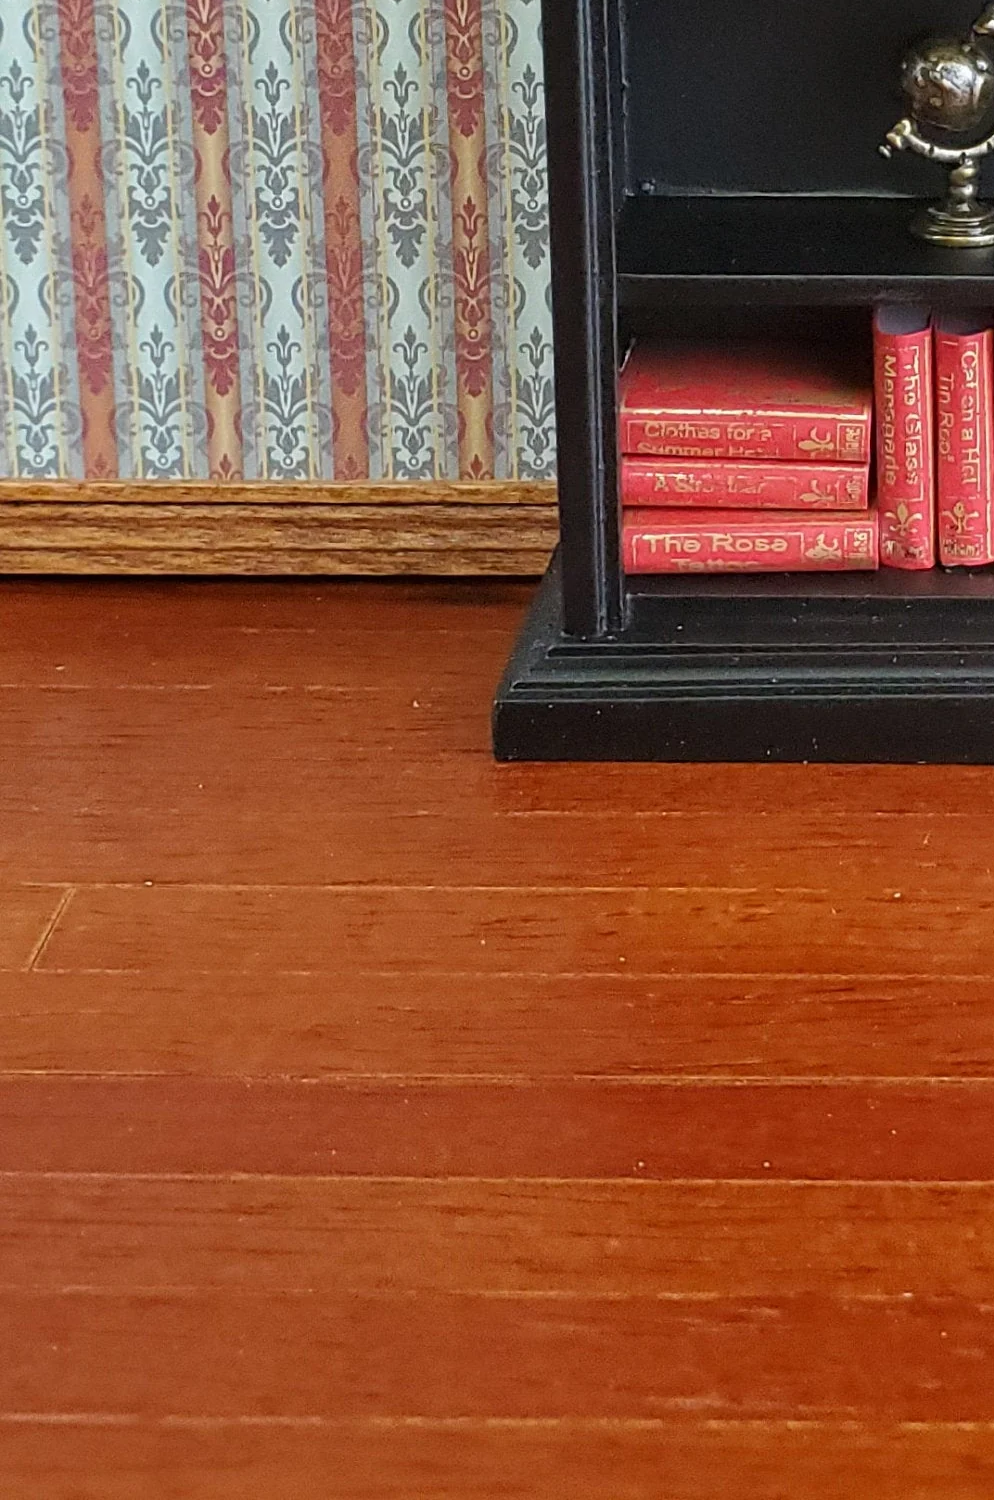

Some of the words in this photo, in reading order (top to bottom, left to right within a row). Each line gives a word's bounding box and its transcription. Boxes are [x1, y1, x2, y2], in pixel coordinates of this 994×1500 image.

[903, 349, 920, 406] The
[961, 350, 978, 389] Cat
[938, 373, 955, 404] Tin
[961, 396, 975, 422] on
[643, 421, 720, 441] Clothes
[727, 424, 755, 442] for
[961, 428, 974, 441] a
[905, 413, 923, 485] Glass
[642, 535, 701, 553] The
[711, 534, 788, 553] Rose
